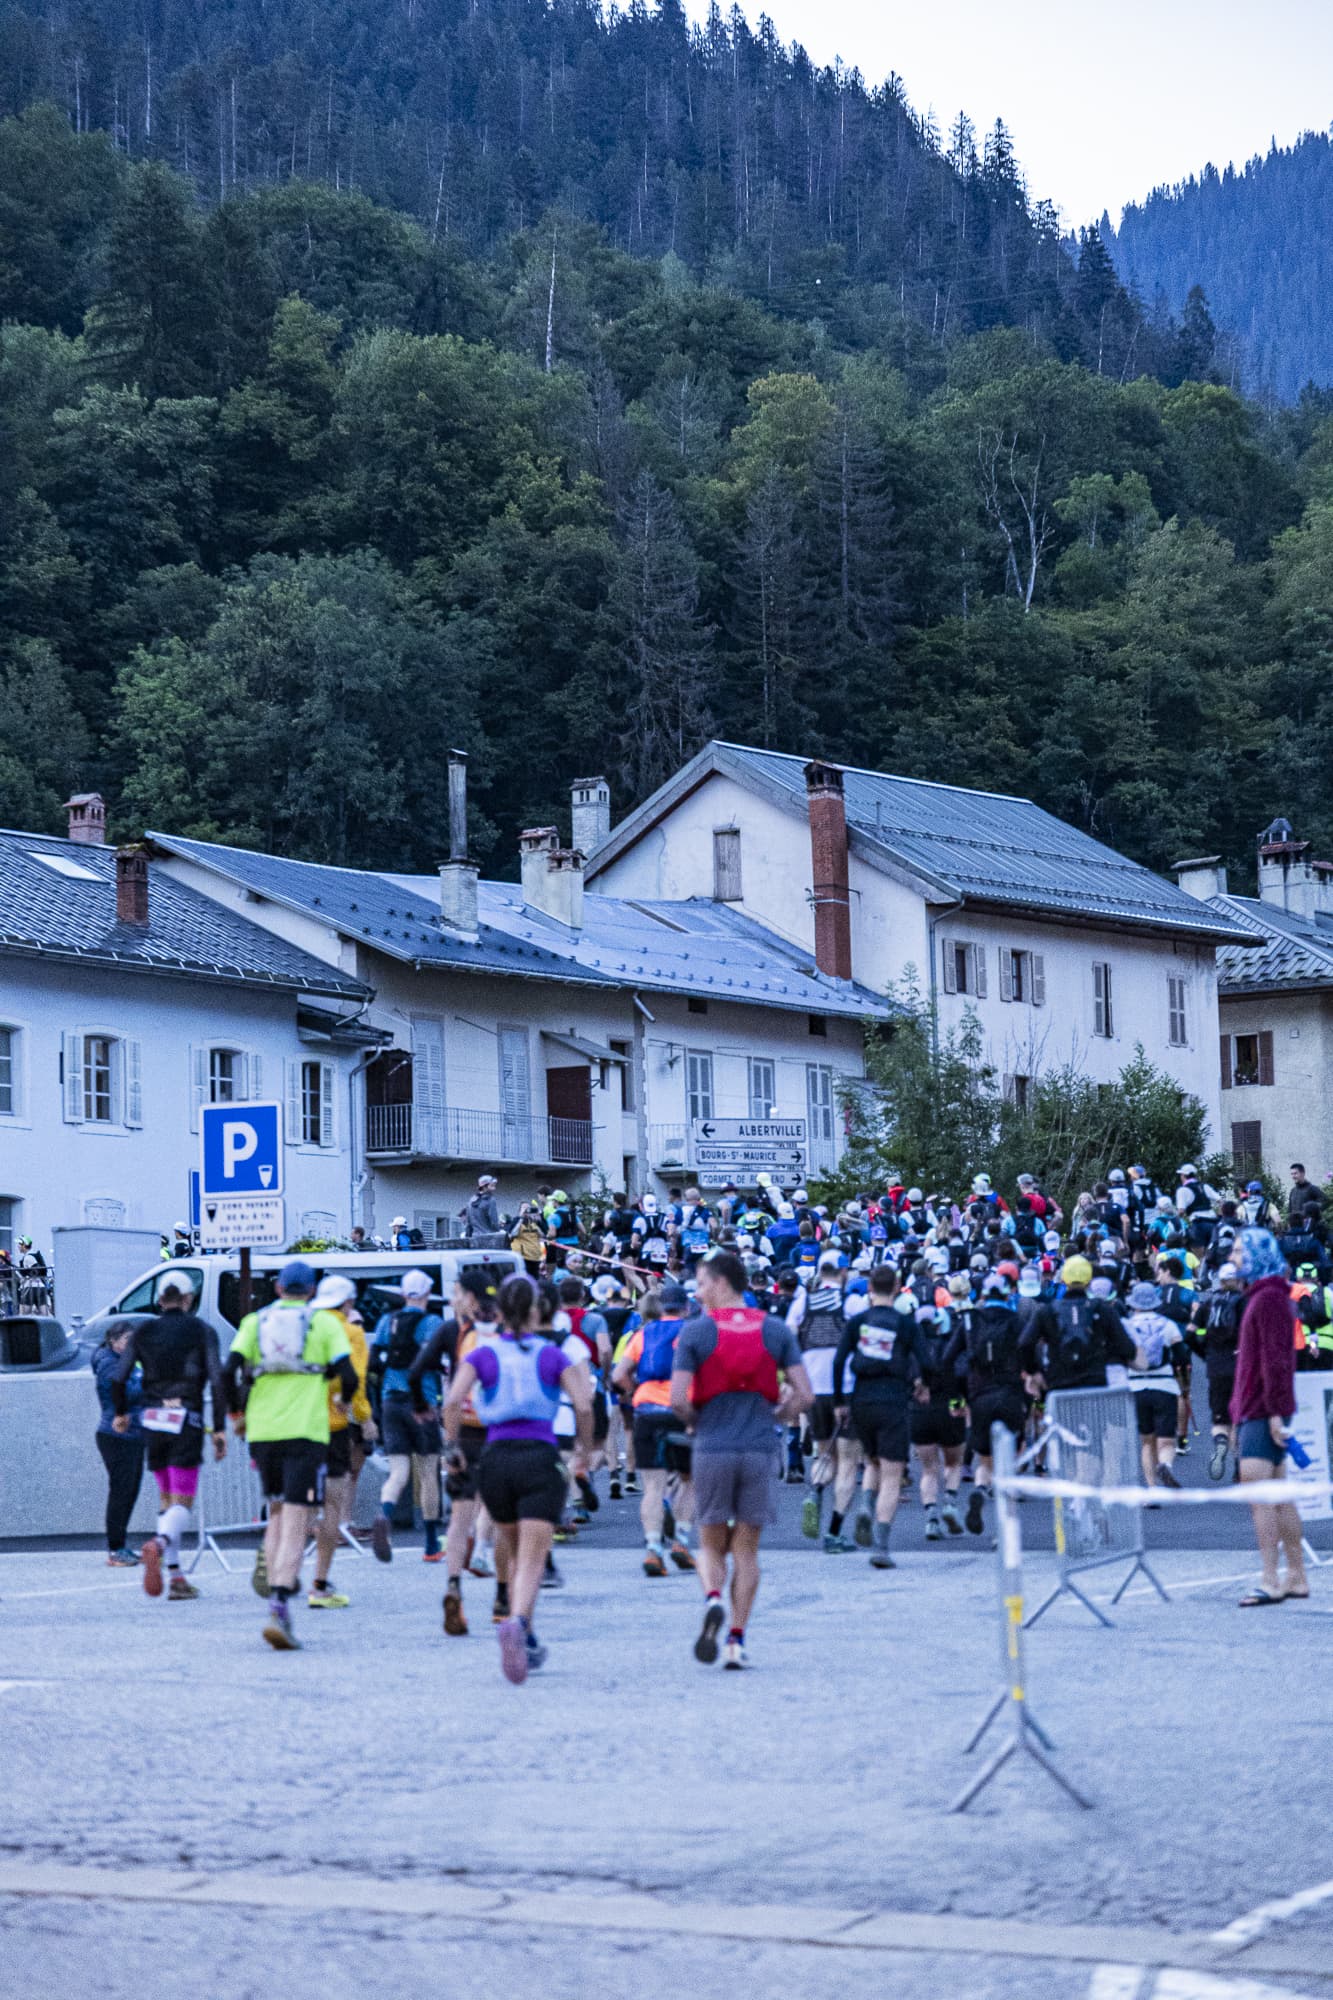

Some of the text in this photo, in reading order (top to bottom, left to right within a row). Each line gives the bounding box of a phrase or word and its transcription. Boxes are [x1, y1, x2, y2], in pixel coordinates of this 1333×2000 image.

[739, 1125, 802, 1137] ALBERTVILLE
[223, 1121, 259, 1179] P
[737, 1174, 745, 1184] DE
